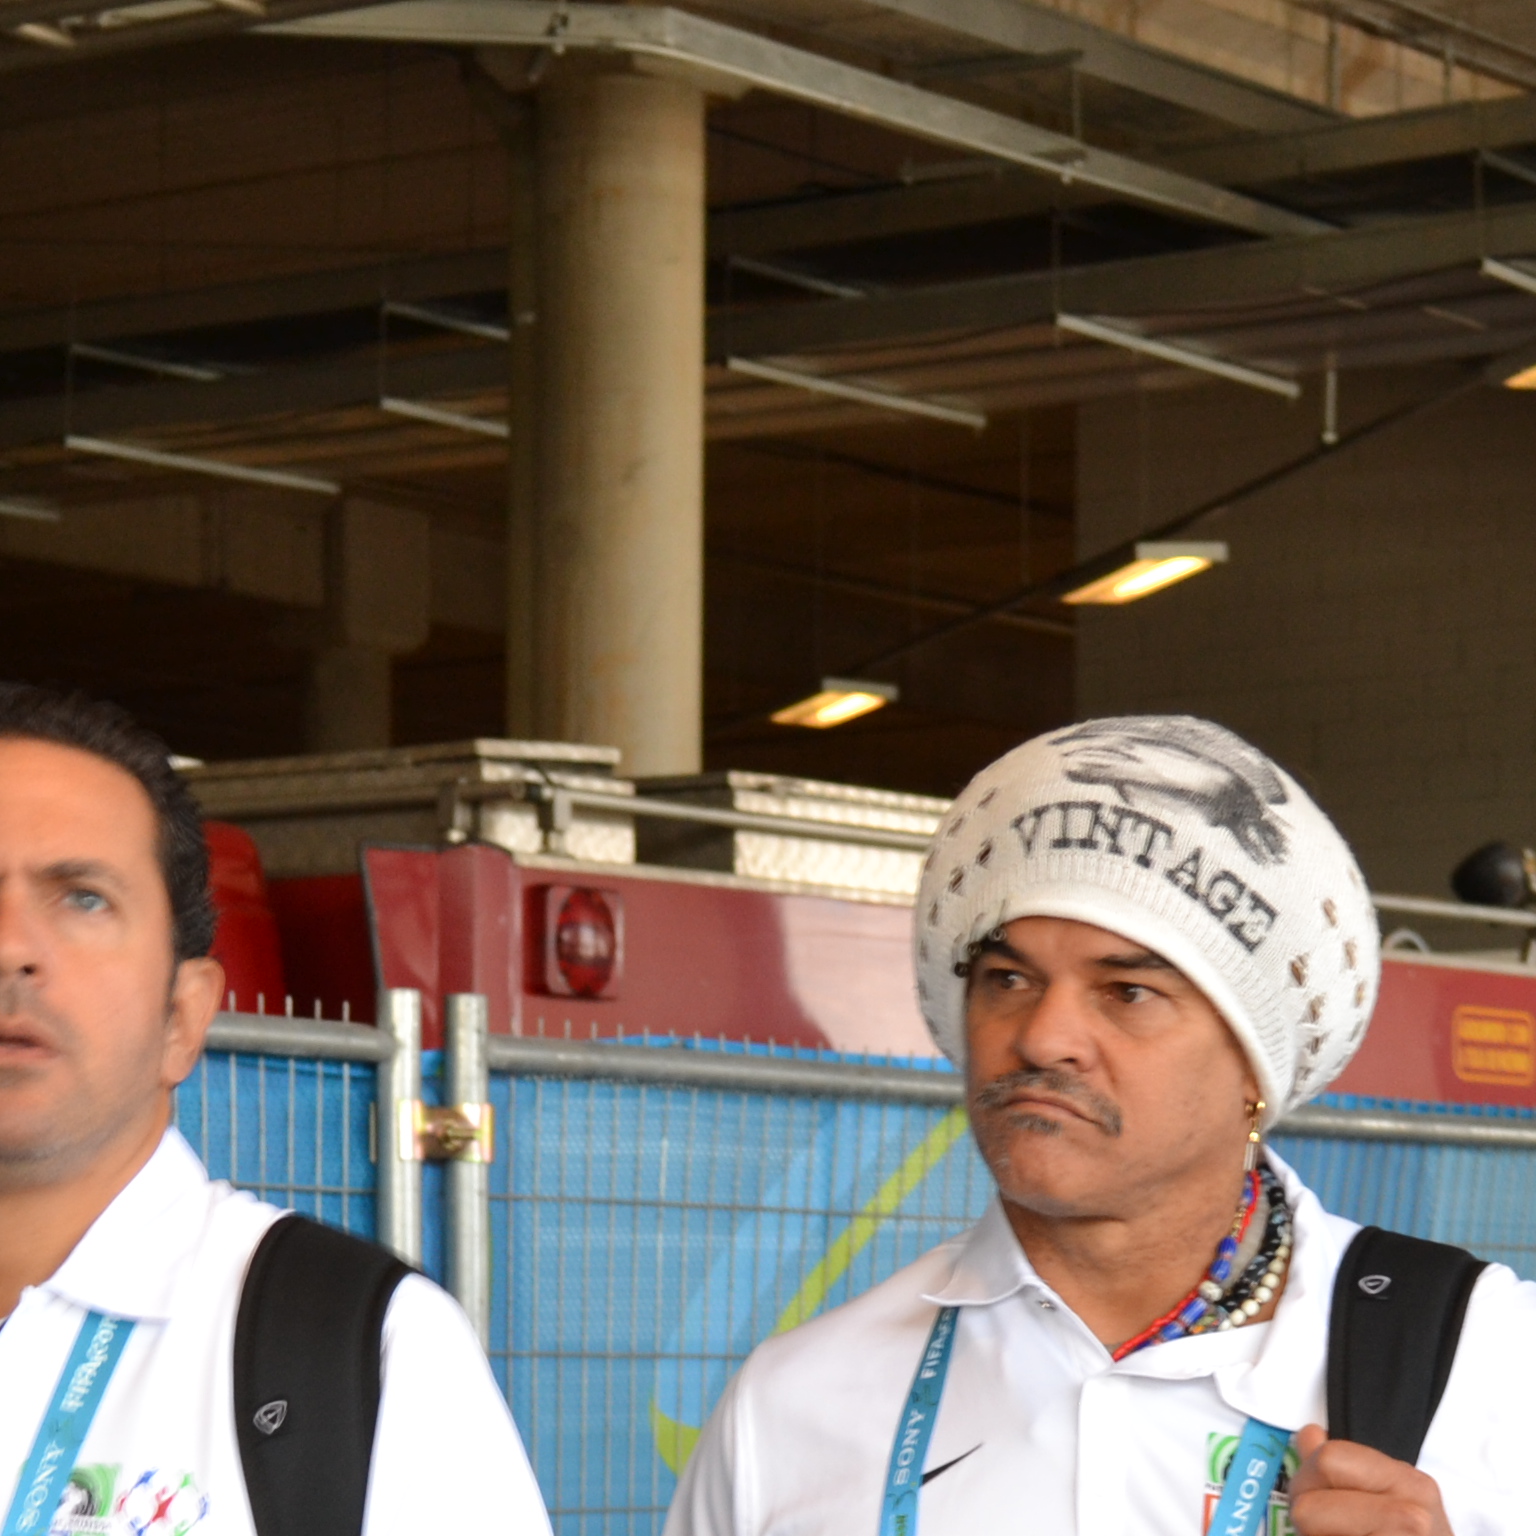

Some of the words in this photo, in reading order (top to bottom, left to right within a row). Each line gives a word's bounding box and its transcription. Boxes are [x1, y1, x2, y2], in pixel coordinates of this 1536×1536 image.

[1010, 800, 1280, 953] VINTAGE
[16, 1440, 66, 1533] SONY
[893, 1408, 926, 1486] SONY
